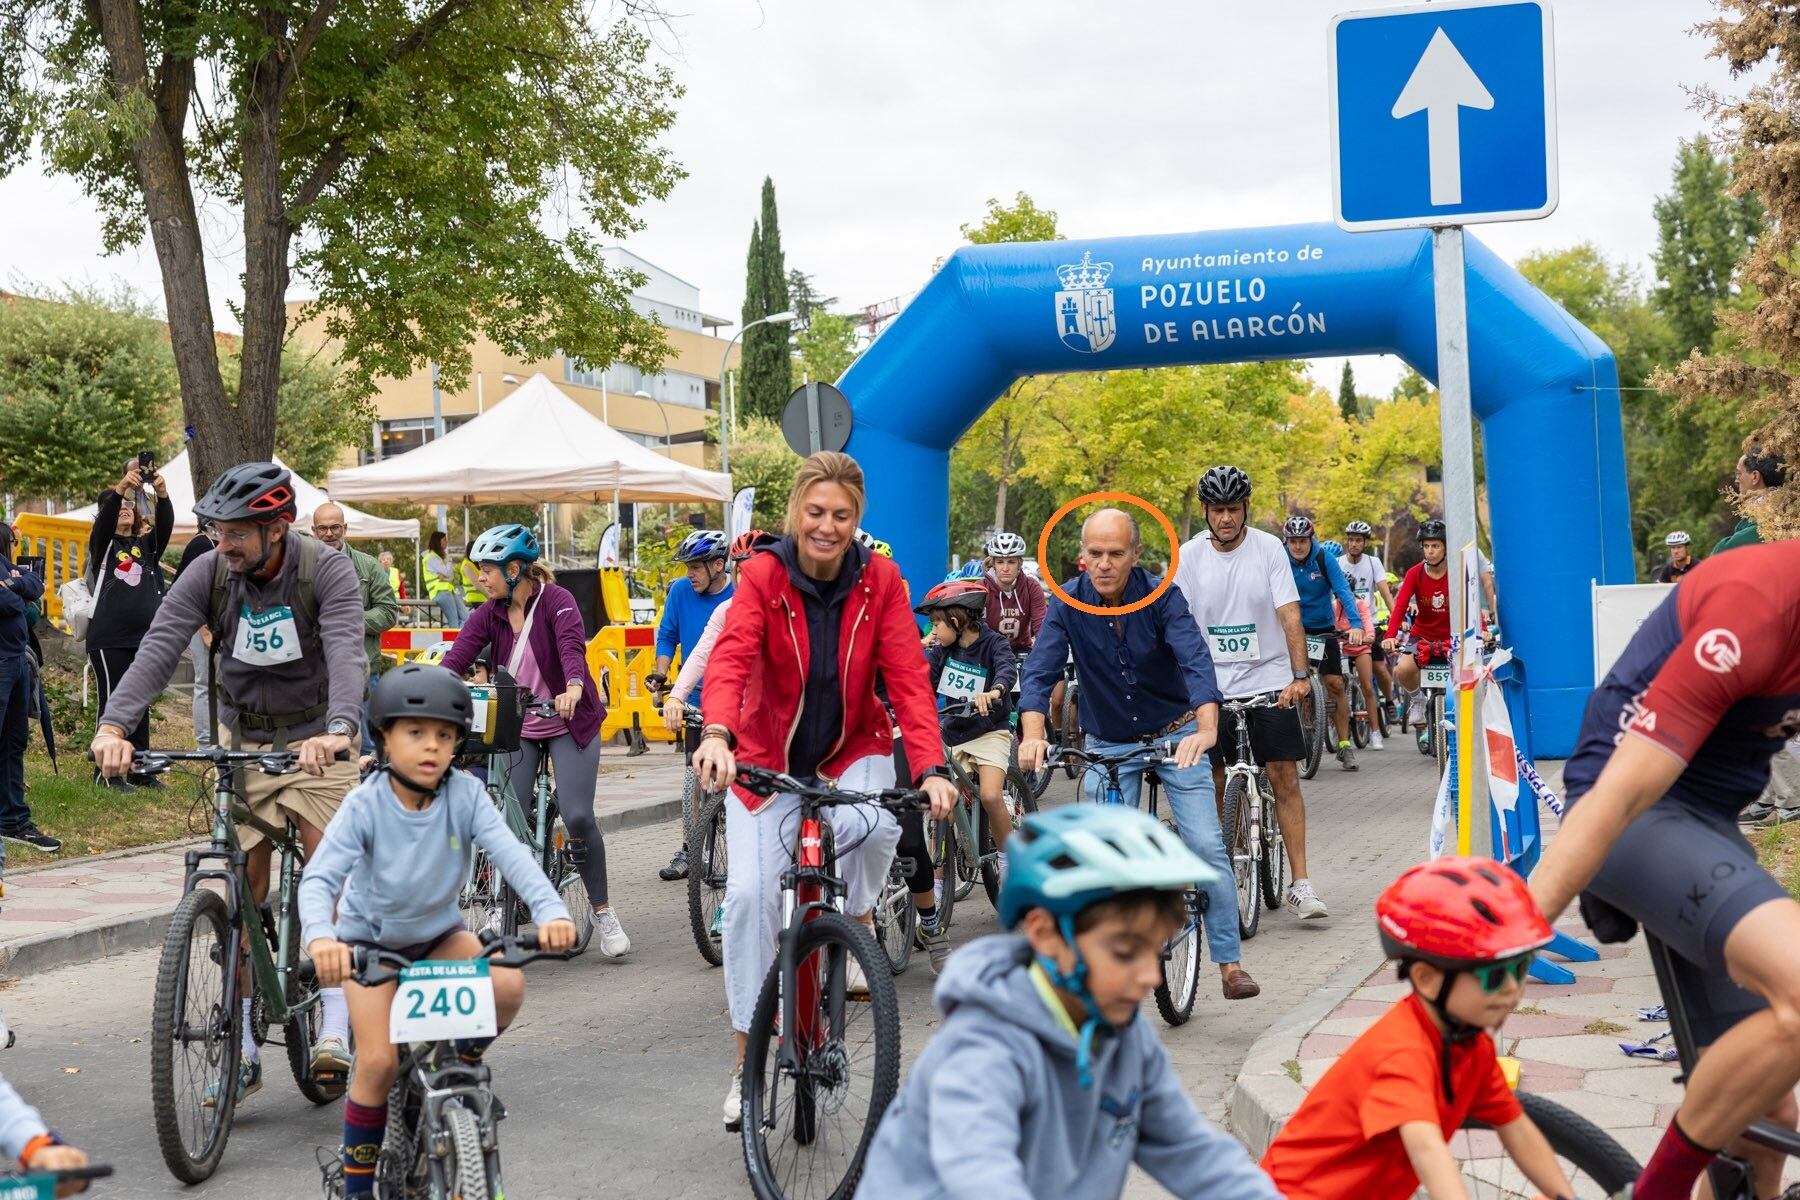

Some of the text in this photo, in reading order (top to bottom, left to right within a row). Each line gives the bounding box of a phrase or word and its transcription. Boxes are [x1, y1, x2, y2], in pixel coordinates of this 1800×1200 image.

[1142, 245, 1323, 275] Ayuntamiento de
[1141, 277, 1266, 308] POZUELO
[1144, 302, 1326, 343] DE ALARCÓN
[1217, 637, 1250, 652] 309
[947, 671, 976, 693] 954
[1427, 671, 1450, 682] 859
[406, 986, 476, 1019] 240
